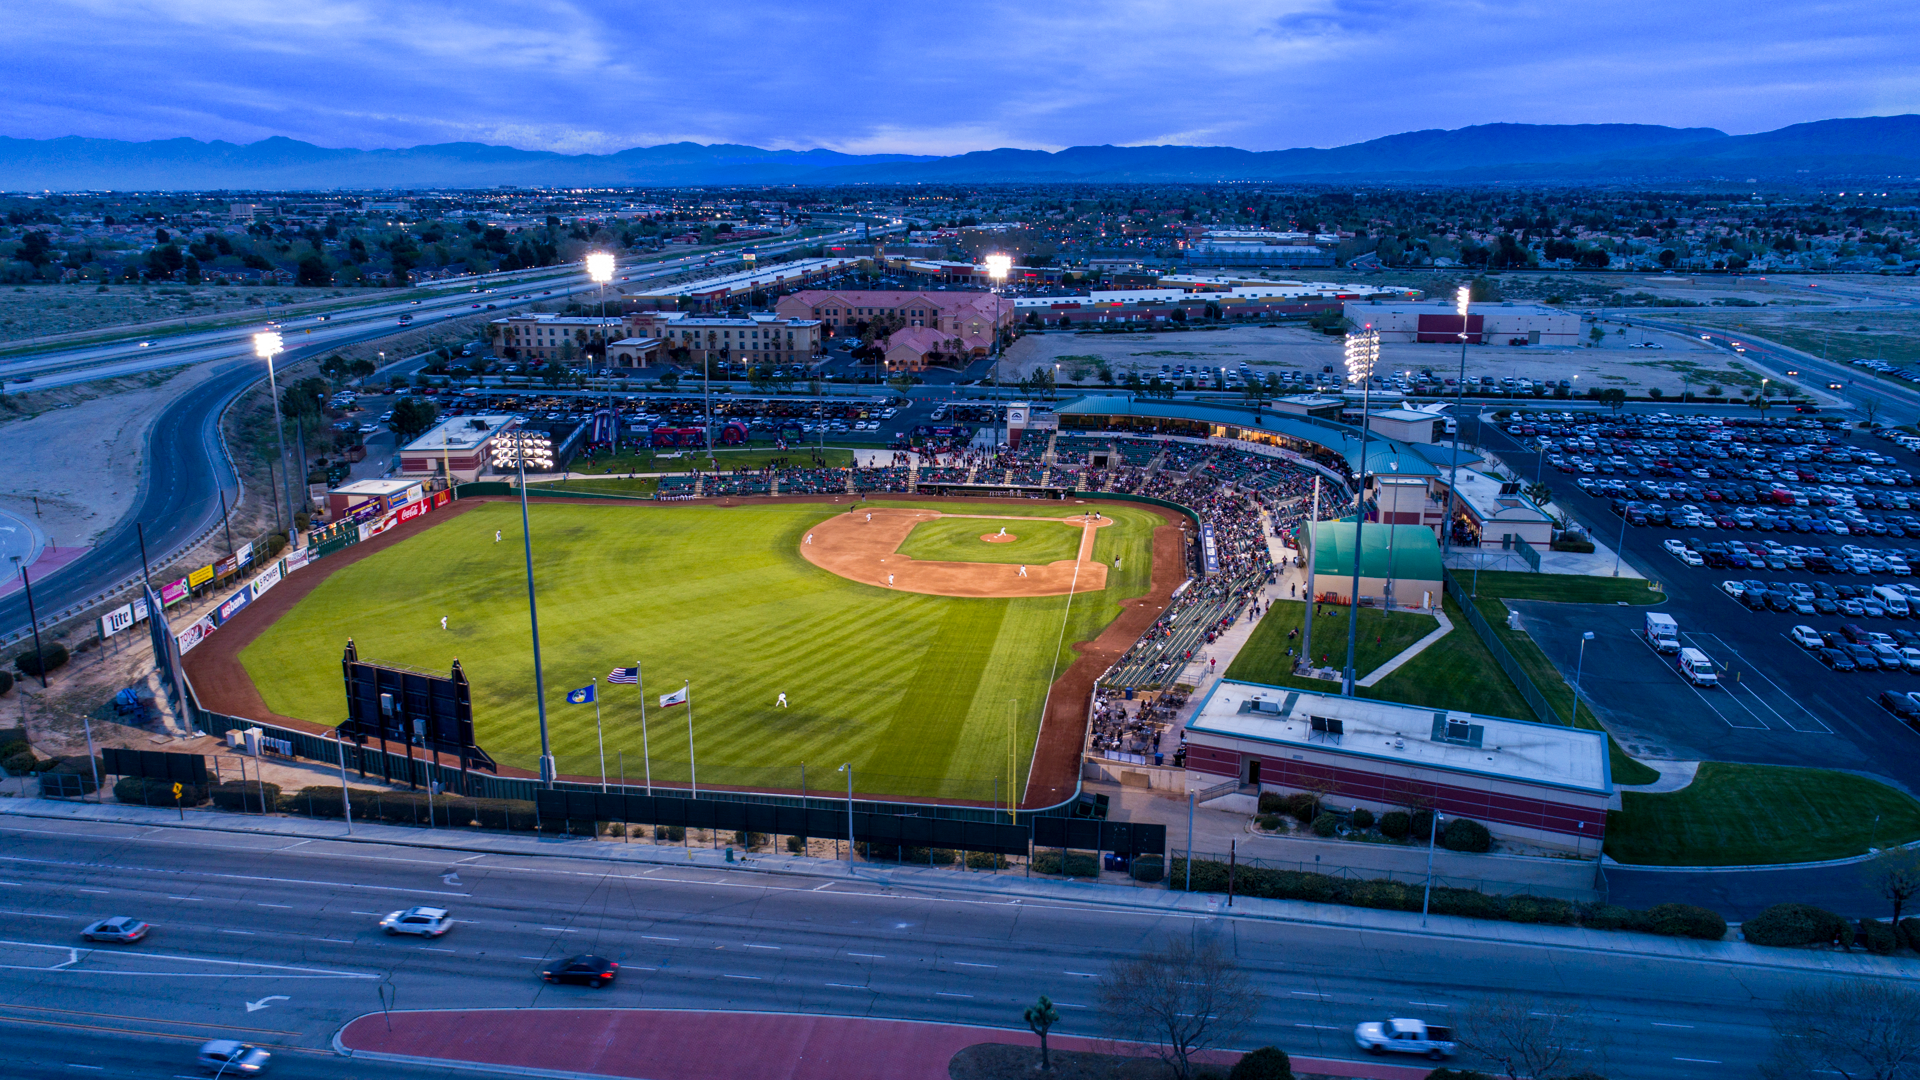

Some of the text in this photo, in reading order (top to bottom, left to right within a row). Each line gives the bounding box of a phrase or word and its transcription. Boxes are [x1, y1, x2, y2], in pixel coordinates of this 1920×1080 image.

[401, 504, 418, 520] Coca-Cola
[263, 567, 278, 584] POWER
[109, 611, 128, 631] Lite
